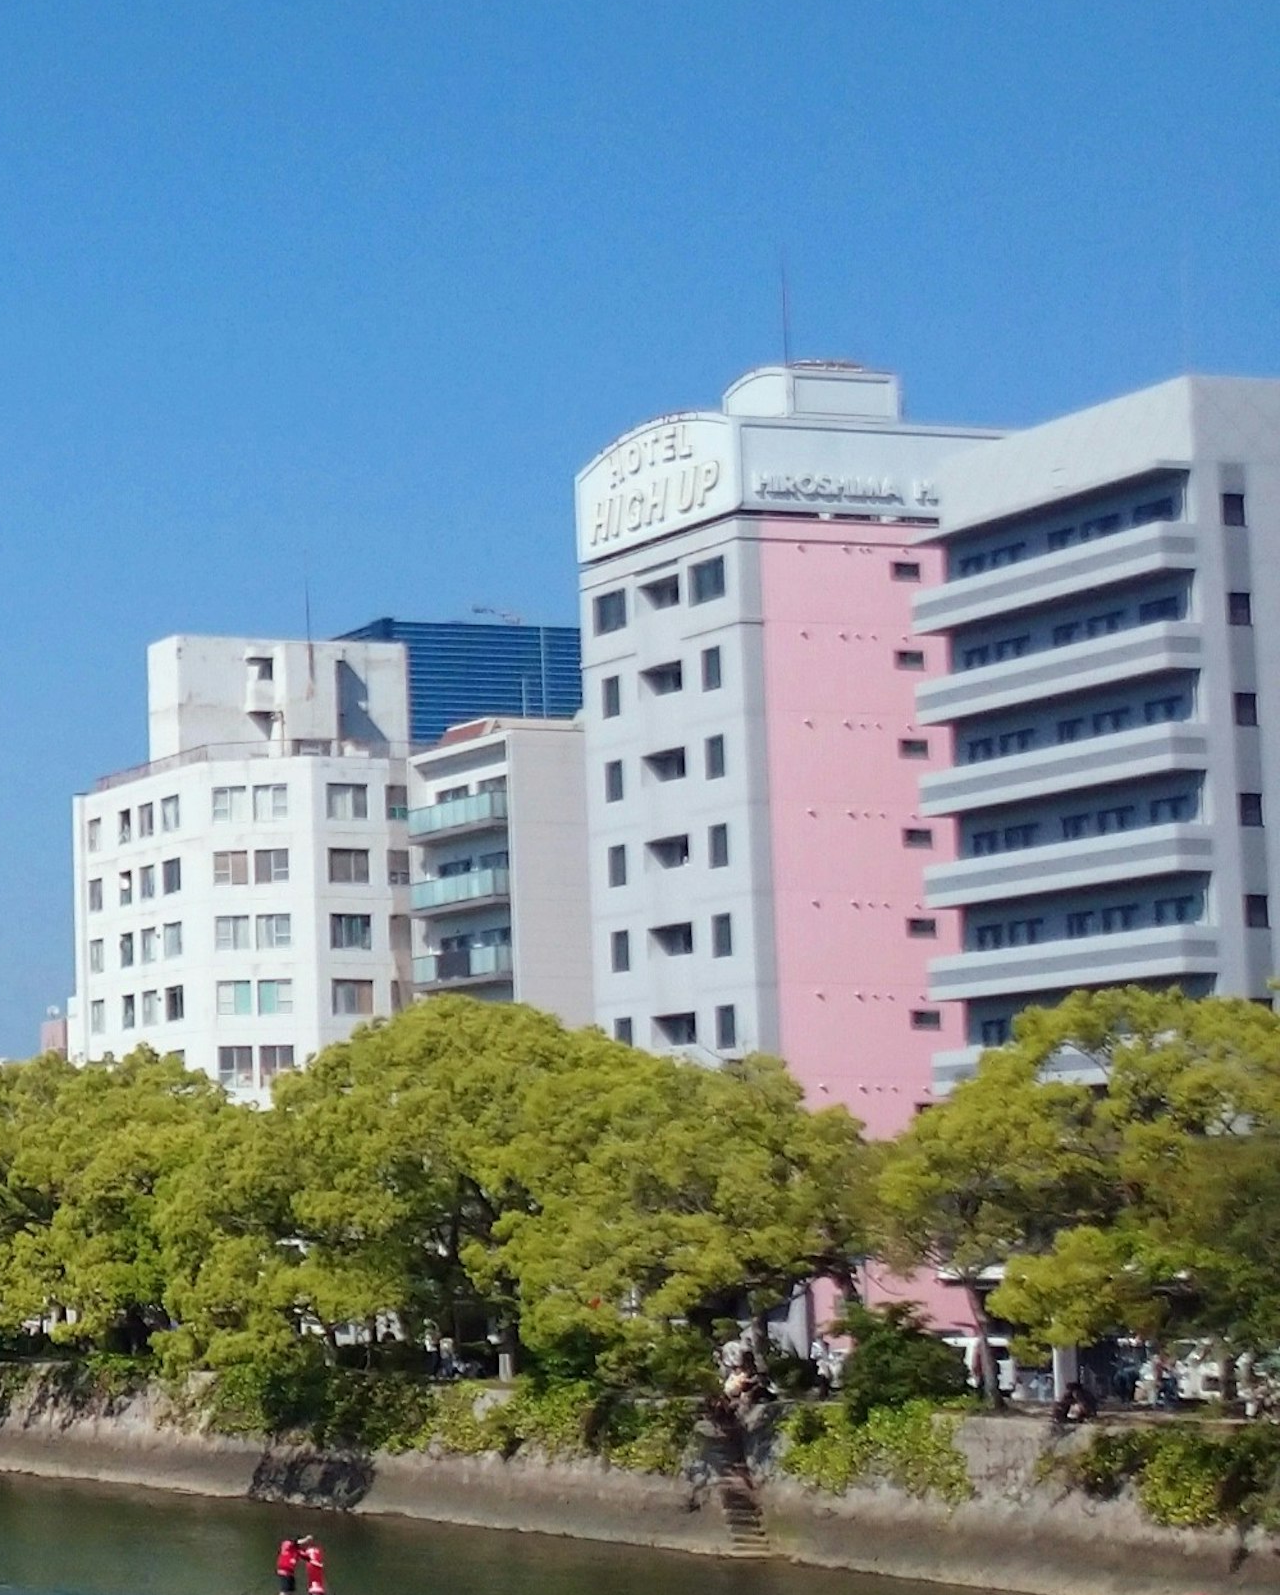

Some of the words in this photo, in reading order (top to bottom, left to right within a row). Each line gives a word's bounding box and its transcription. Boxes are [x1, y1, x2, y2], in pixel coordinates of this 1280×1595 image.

[605, 424, 693, 490] HOTEL
[752, 470, 906, 505] HIROSHIMA
[590, 476, 669, 547] HIGH
[678, 459, 721, 515] UP
